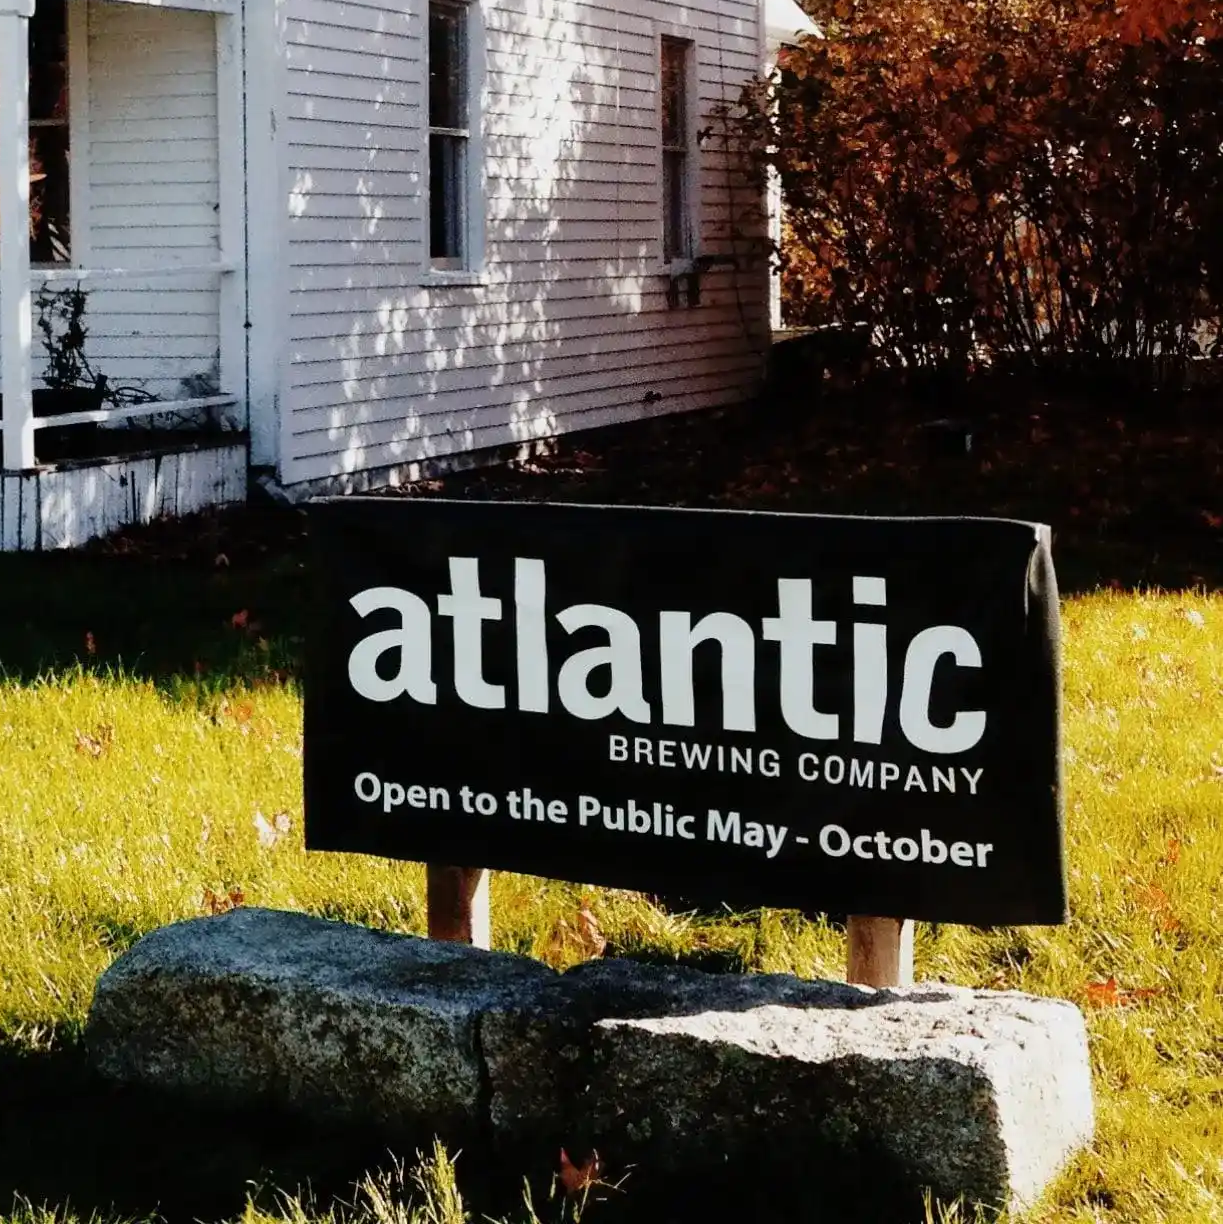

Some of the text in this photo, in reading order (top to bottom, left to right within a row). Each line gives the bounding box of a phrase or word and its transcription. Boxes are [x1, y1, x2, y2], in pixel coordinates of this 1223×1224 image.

[348, 556, 988, 754] atlantic
[609, 734, 984, 795] BREWING COMPANY
[354, 772, 450, 813] Open
[459, 785, 498, 816] to
[506, 787, 568, 824] the
[578, 795, 696, 840] Public
[706, 809, 789, 859] May
[819, 824, 994, 868] October
